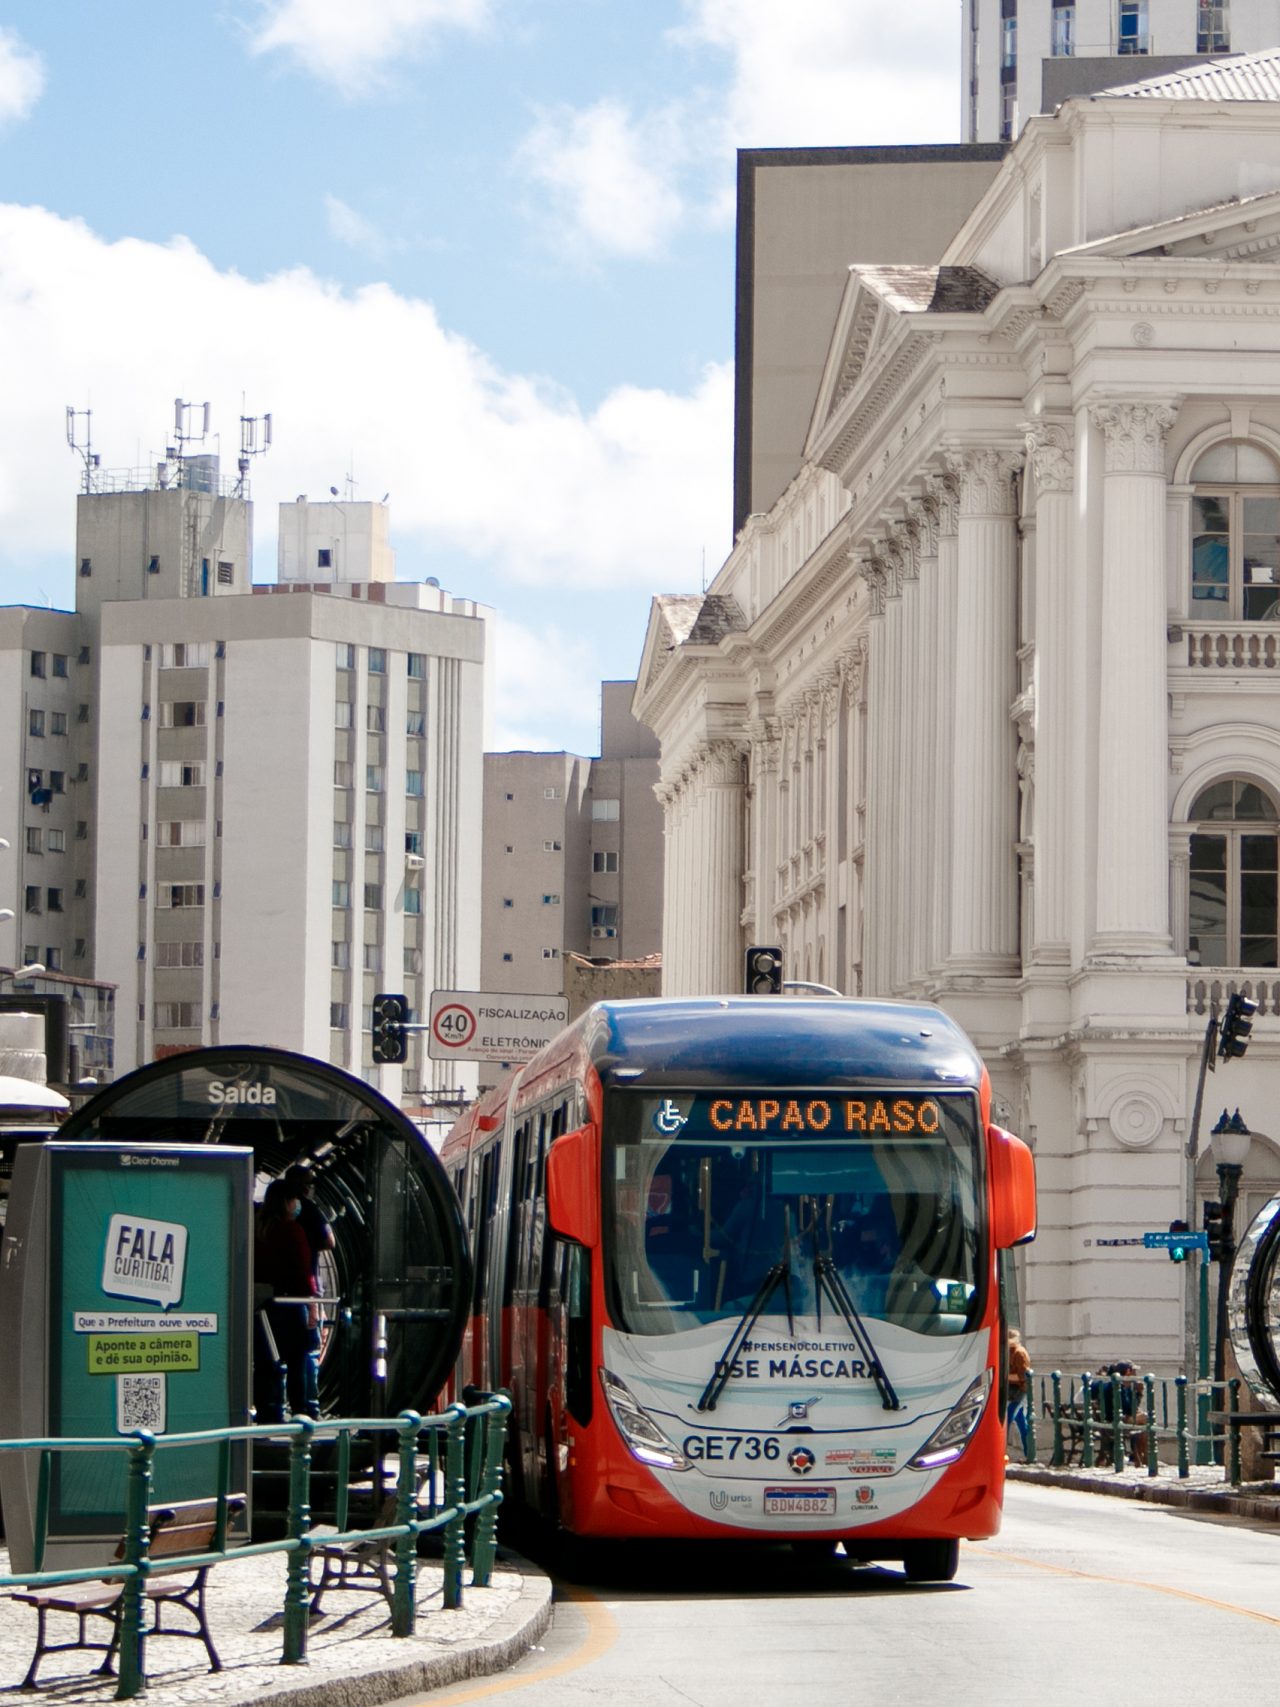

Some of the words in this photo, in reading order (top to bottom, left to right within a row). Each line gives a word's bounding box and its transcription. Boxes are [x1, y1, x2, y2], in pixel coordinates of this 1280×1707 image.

[478, 1008, 566, 1021] FISCALIZAÇÃO
[440, 1014, 468, 1032] 40
[482, 1036, 551, 1049] ELETRÔNIC
[208, 1080, 277, 1104] Saída
[709, 1100, 832, 1131] CAPAO
[845, 1100, 939, 1132] RASO
[116, 1225, 174, 1265] FALA
[113, 1256, 174, 1284] CURITIBA!
[78, 1317, 96, 1328] Que
[99, 1319, 105, 1327] a
[108, 1317, 156, 1328] Prefeitura
[159, 1319, 182, 1328] ouve
[186, 1317, 213, 1328] você.
[95, 1340, 136, 1353] Aponte
[139, 1342, 146, 1350] a
[149, 1338, 192, 1350] câmera
[741, 1340, 856, 1353] #PENSENOCOLETIVO
[96, 1356, 103, 1365] e
[105, 1353, 120, 1364] dê
[123, 1355, 143, 1364] sua
[145, 1351, 192, 1365] opinião.
[682, 1435, 780, 1461] GE736
[770, 1499, 828, 1512] BDW4B82
